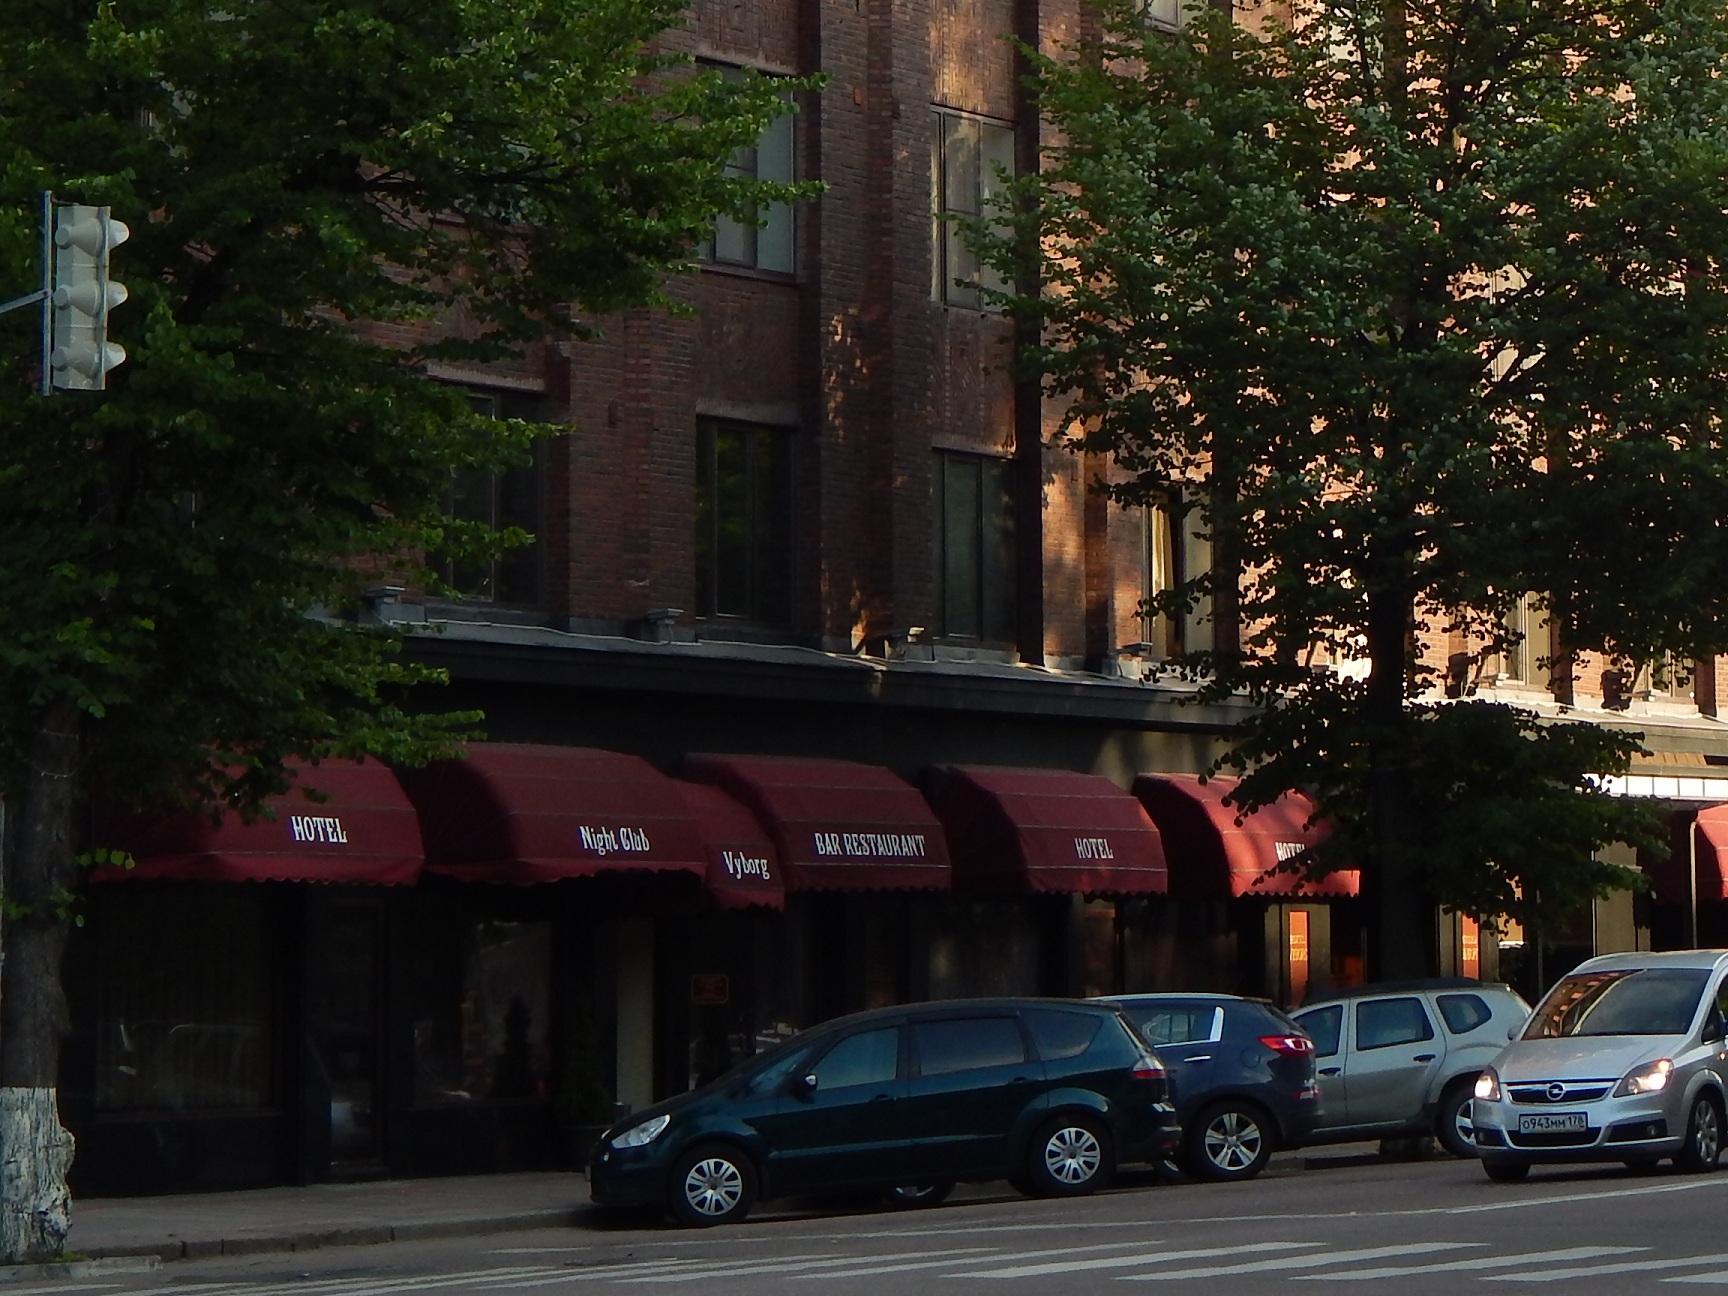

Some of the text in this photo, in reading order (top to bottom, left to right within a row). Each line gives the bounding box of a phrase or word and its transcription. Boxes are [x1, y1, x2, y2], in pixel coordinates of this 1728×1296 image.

[290, 815, 348, 844] HOTEL
[579, 825, 651, 856] Night Club
[814, 832, 926, 857] BAR RESTAURANT
[1073, 837, 1114, 859] HOTEL
[721, 851, 771, 881] Vyborg
